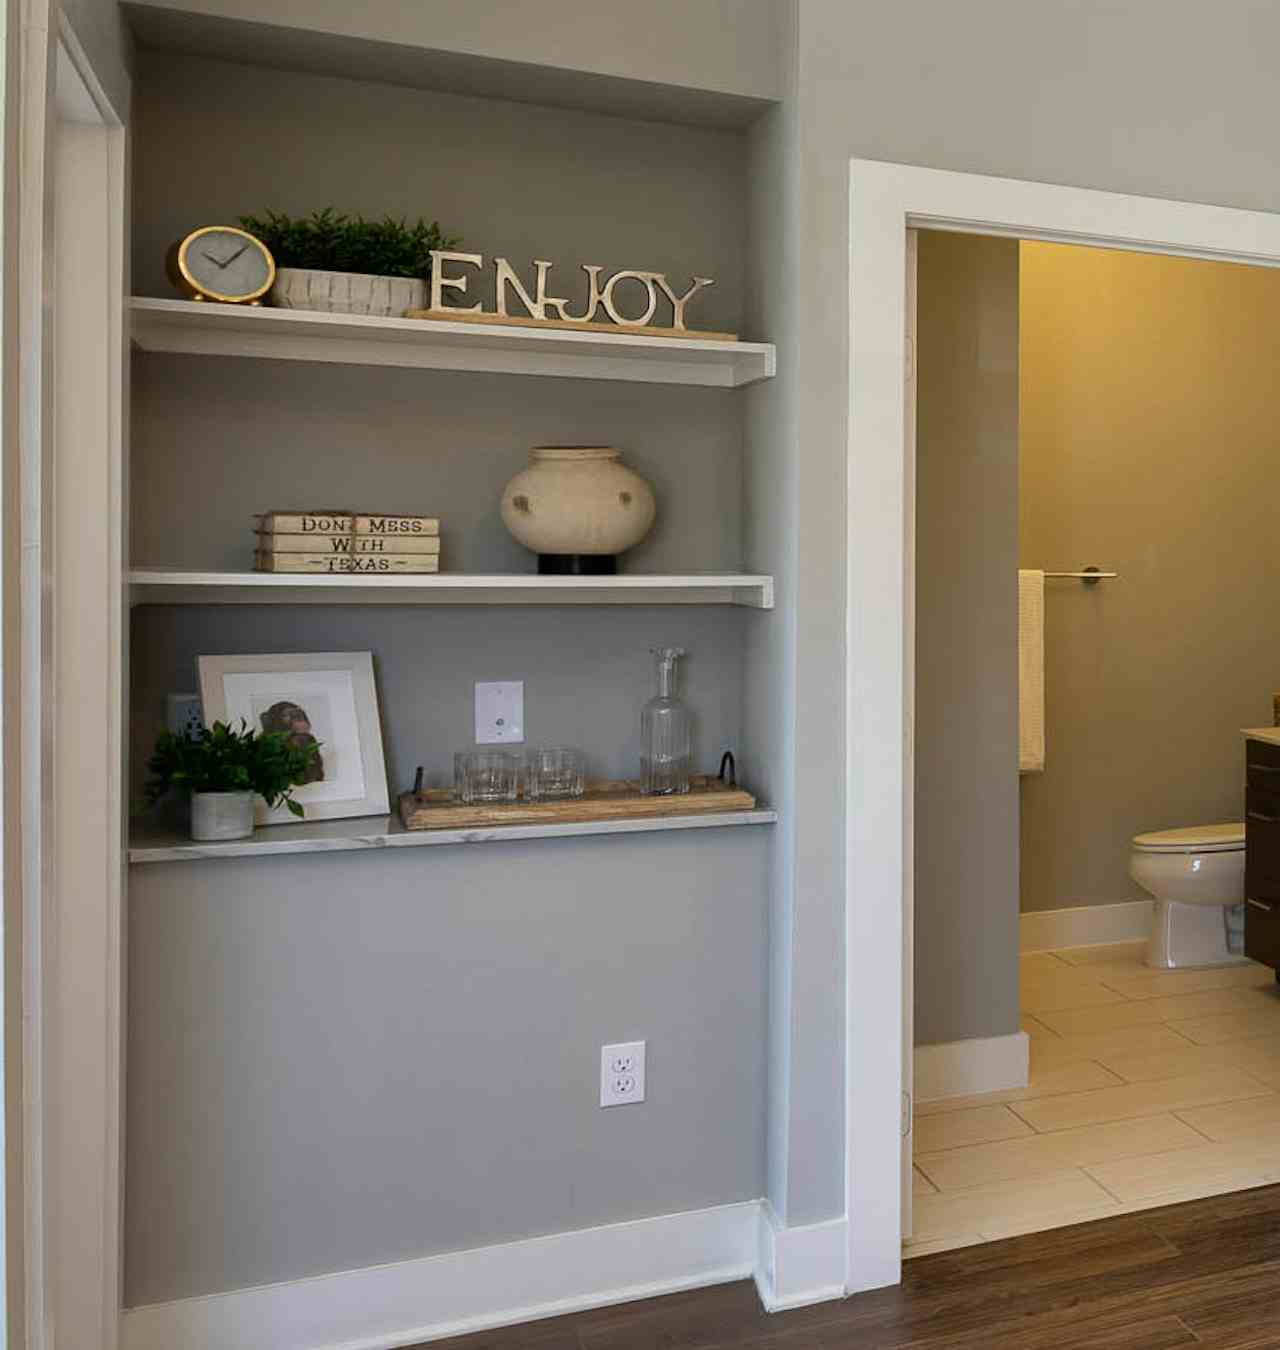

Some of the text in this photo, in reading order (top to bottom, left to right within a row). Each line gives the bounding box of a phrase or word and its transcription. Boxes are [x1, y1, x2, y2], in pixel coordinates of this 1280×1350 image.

[429, 250, 715, 331] ENJOY
[369, 519, 424, 533] MESS
[324, 556, 390, 571] TEXAS
